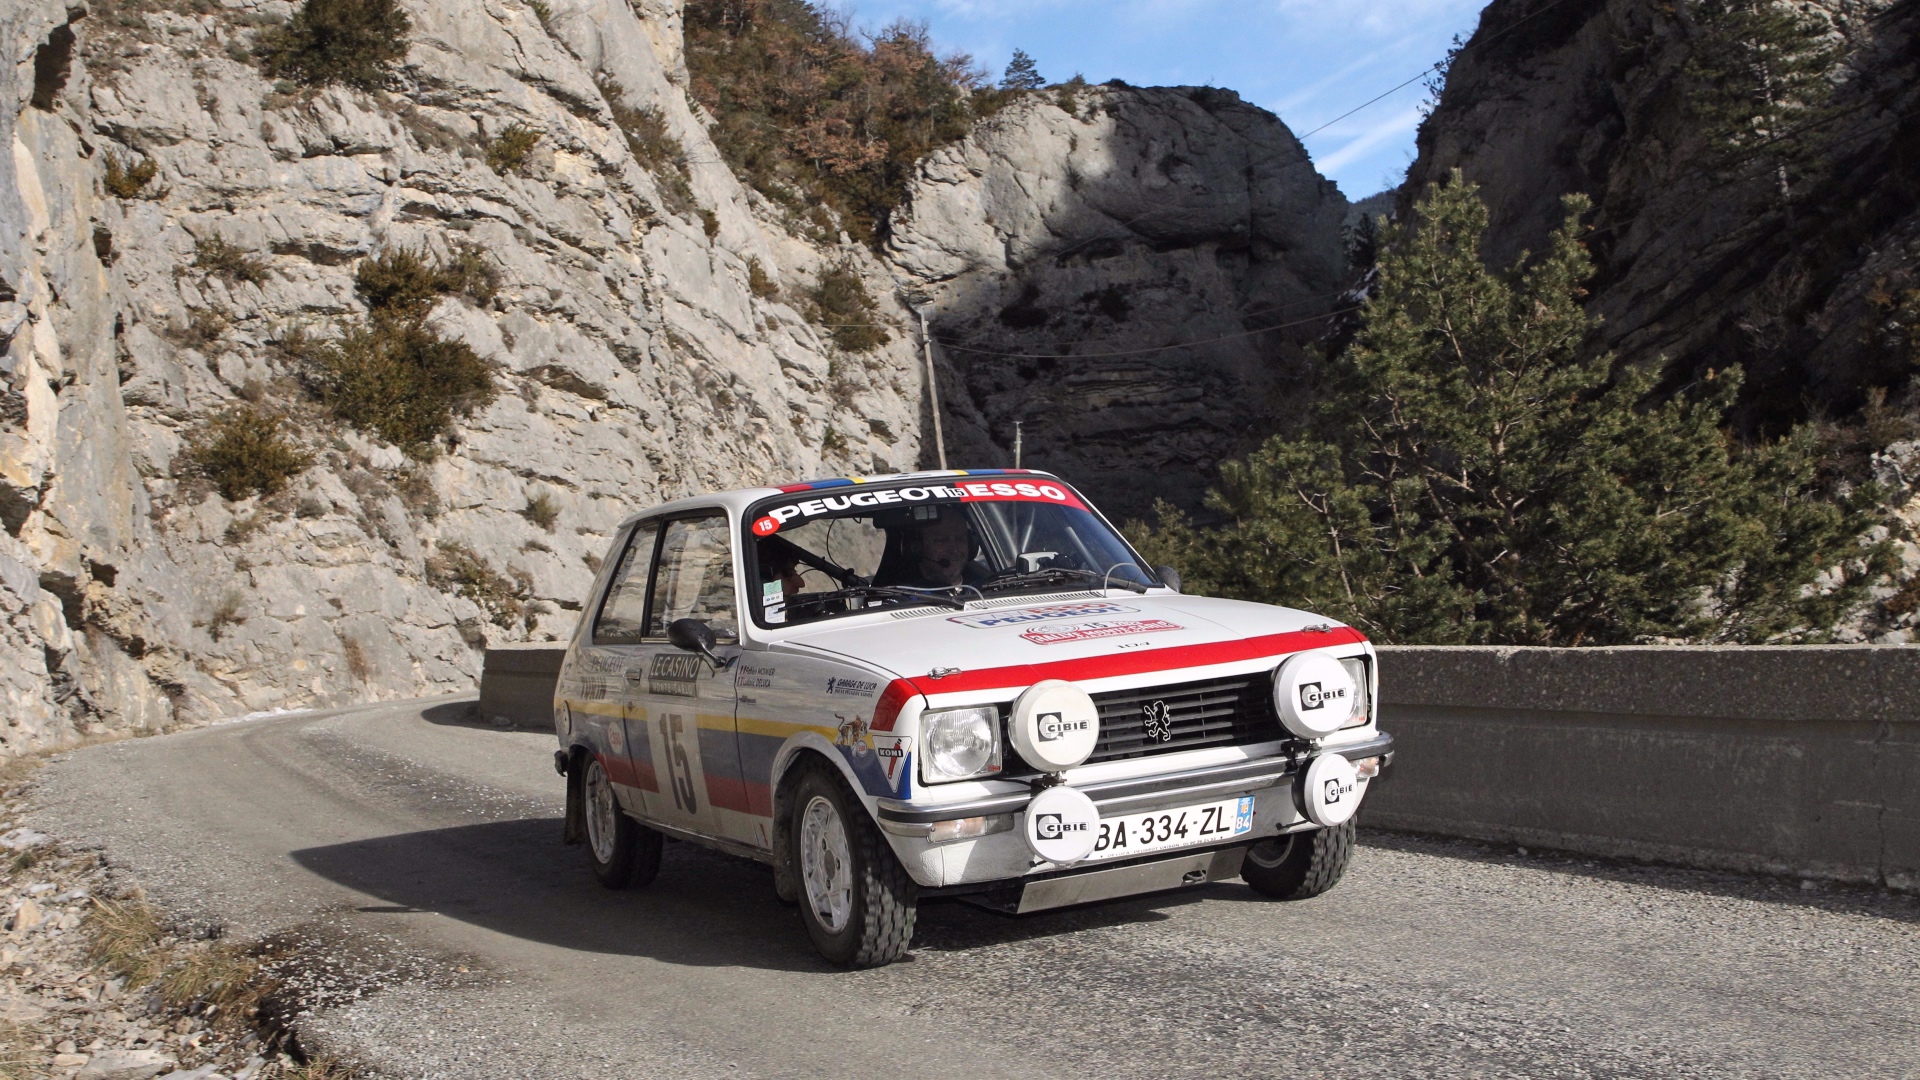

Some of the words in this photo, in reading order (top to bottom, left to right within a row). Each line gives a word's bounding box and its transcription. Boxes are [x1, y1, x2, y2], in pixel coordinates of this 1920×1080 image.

[768, 485, 948, 523] PEUGEOT
[948, 488, 965, 497] 15
[965, 484, 1066, 500] ESSO
[758, 520, 774, 532] 15
[979, 606, 1123, 626] PEUGEOT
[660, 713, 698, 815] 15
[1236, 816, 1250, 829] 84
